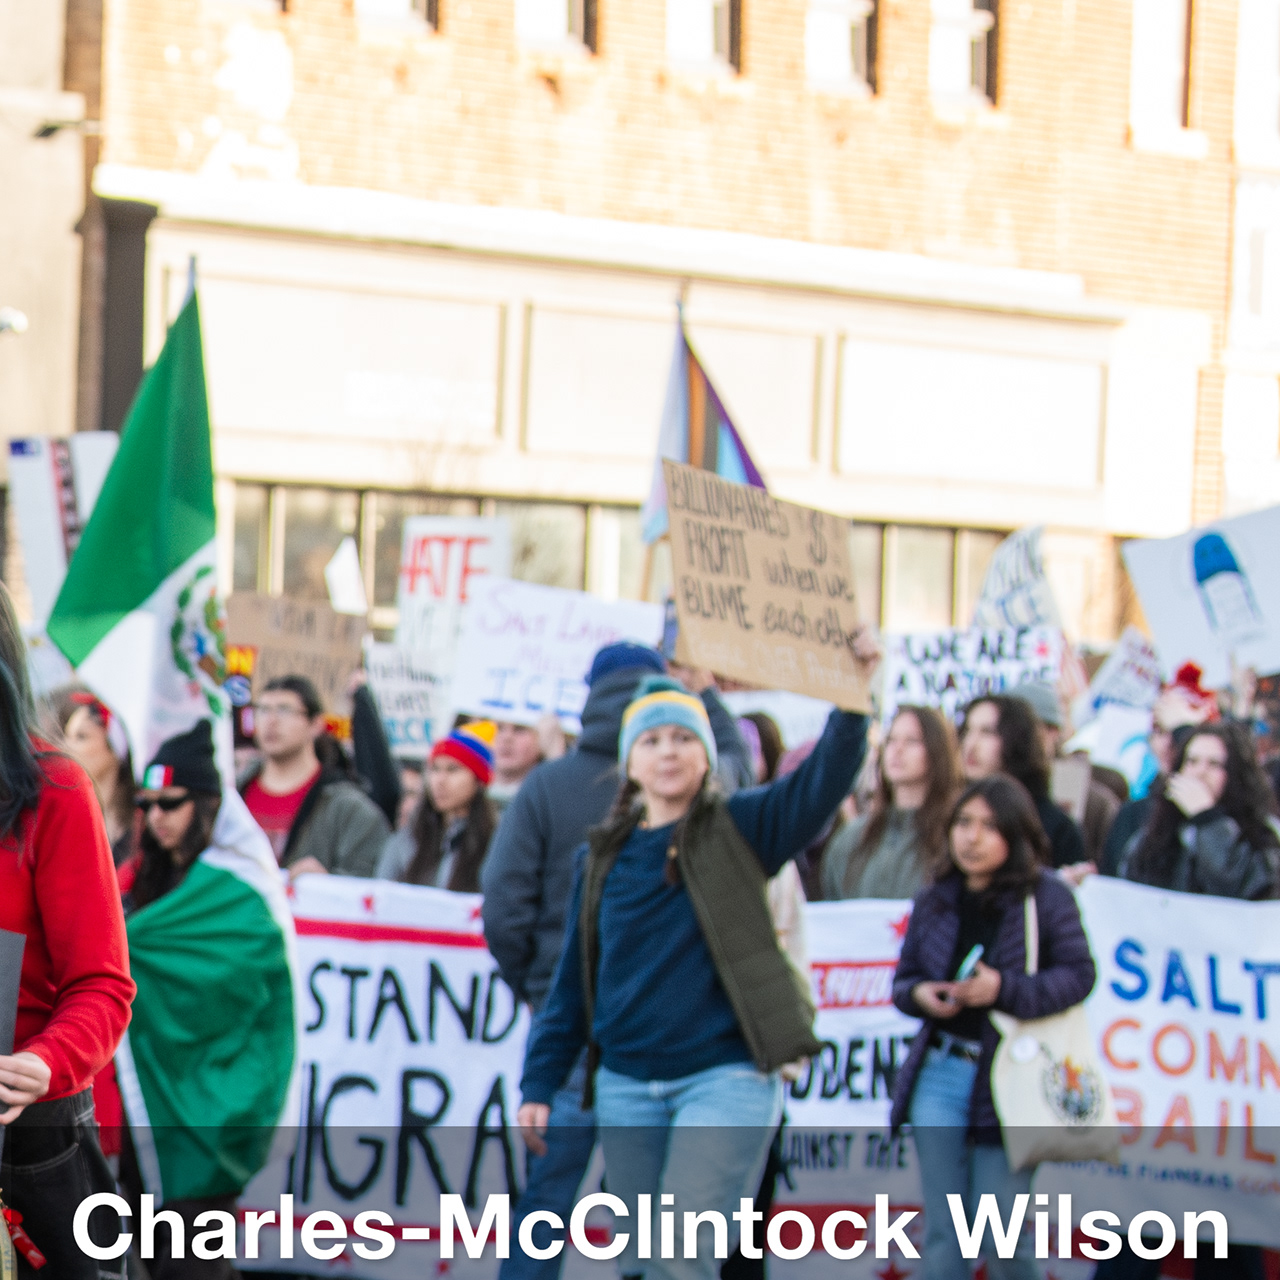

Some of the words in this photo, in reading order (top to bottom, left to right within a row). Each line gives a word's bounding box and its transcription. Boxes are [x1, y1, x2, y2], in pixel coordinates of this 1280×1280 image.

[684, 516, 751, 581] PROFIT
[682, 574, 755, 632] BLAME
[976, 624, 1032, 664] ARE
[306, 960, 521, 1045] STAND
[1109, 936, 1280, 1022] SALT
[1110, 1086, 1277, 1166] BAIL
